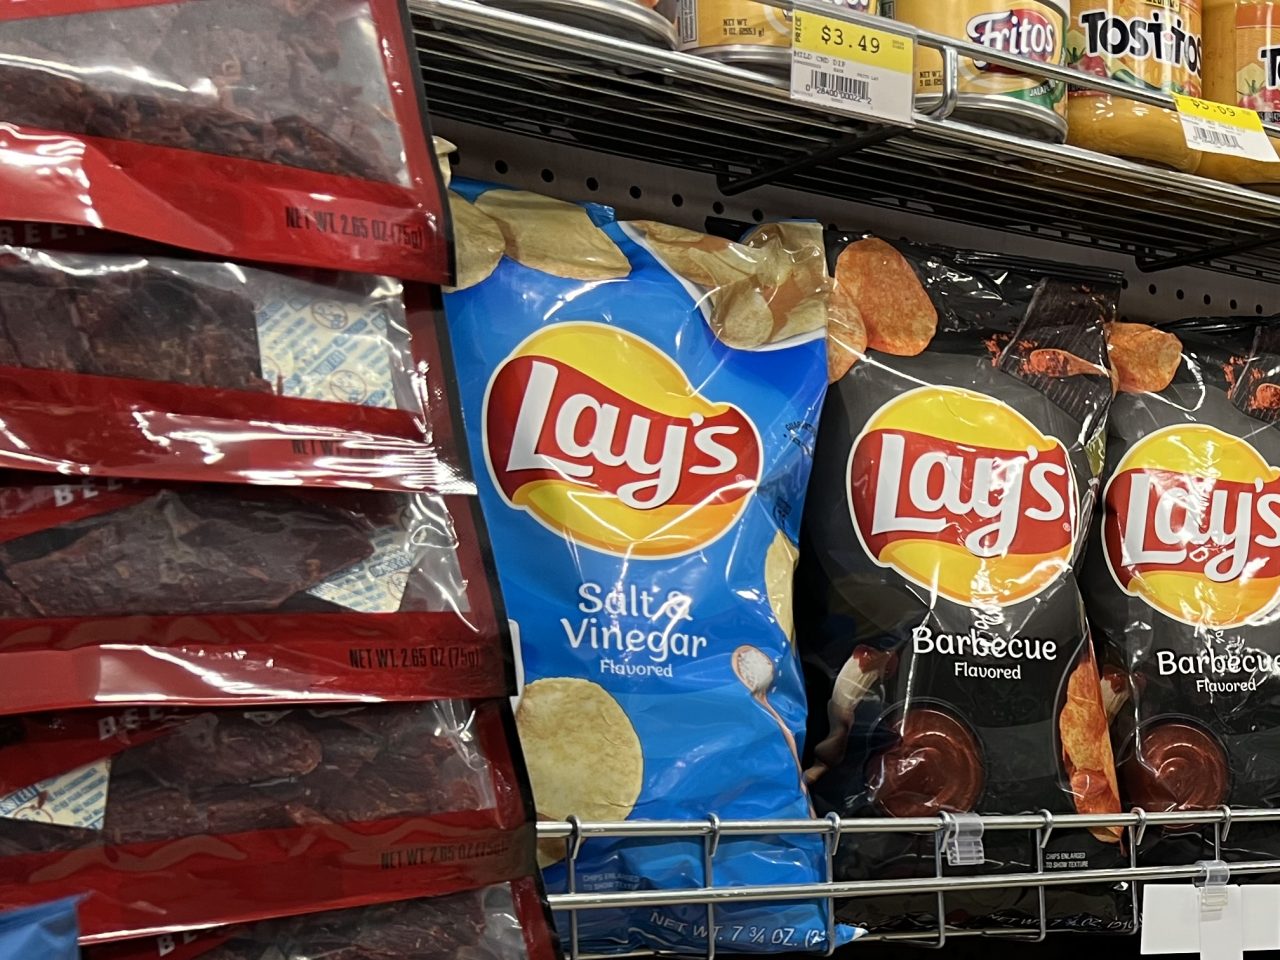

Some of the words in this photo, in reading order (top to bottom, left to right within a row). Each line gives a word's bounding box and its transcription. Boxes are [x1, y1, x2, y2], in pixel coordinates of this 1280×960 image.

[821, 25, 881, 54] $3.49
[966, 9, 1055, 72] Fritos
[286, 206, 311, 229] NET
[341, 215, 368, 239] 2.65
[506, 360, 740, 509] Lay's
[871, 434, 1066, 557] Lay's
[578, 583, 653, 618] Salt
[560, 618, 707, 663] Vinegar
[911, 627, 1057, 661] Barbecue
[350, 650, 374, 669] NET
[376, 650, 398, 668] WT.
[401, 649, 426, 668] 2.65
[431, 648, 446, 667] OZ
[449, 648, 480, 673] (75g)
[600, 658, 673, 678] Flavored
[953, 661, 1022, 680] Flavored
[1196, 678, 1257, 693] Flavored
[381, 851, 403, 870] NET
[649, 911, 686, 932] NET
[731, 926, 740, 942] 7
[772, 928, 798, 947] OZ.
